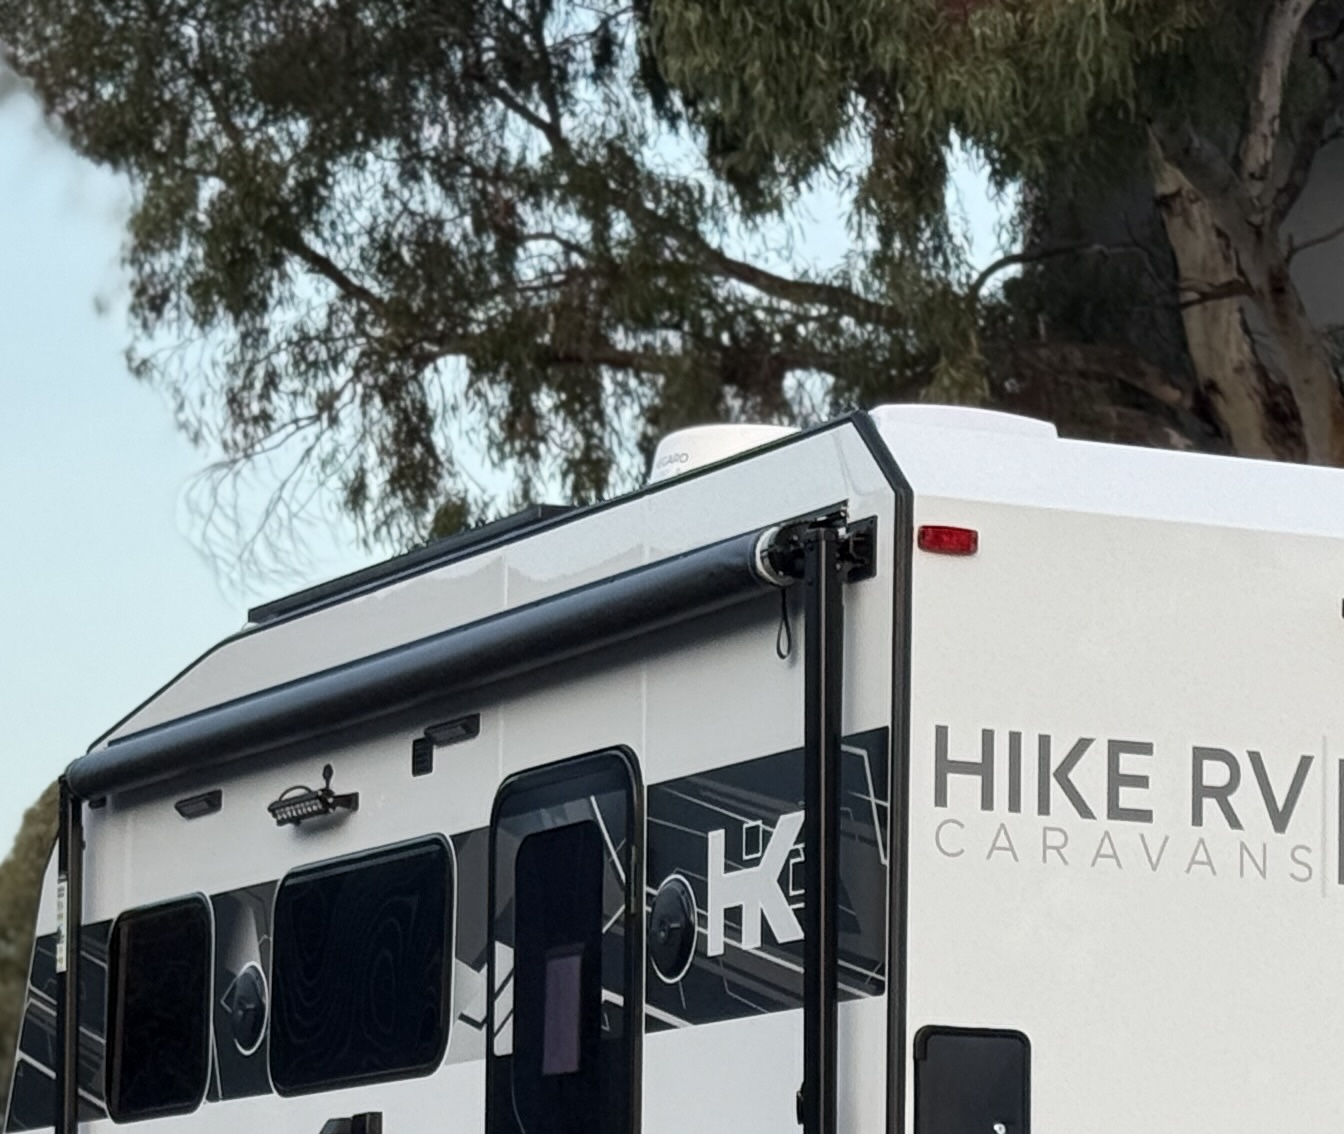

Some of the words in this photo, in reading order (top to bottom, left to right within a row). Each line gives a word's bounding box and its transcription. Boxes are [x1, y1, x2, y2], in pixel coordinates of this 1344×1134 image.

[934, 724, 1155, 824] HIKE
[1191, 746, 1315, 835] RV
[934, 818, 1314, 883] CARAVANS
